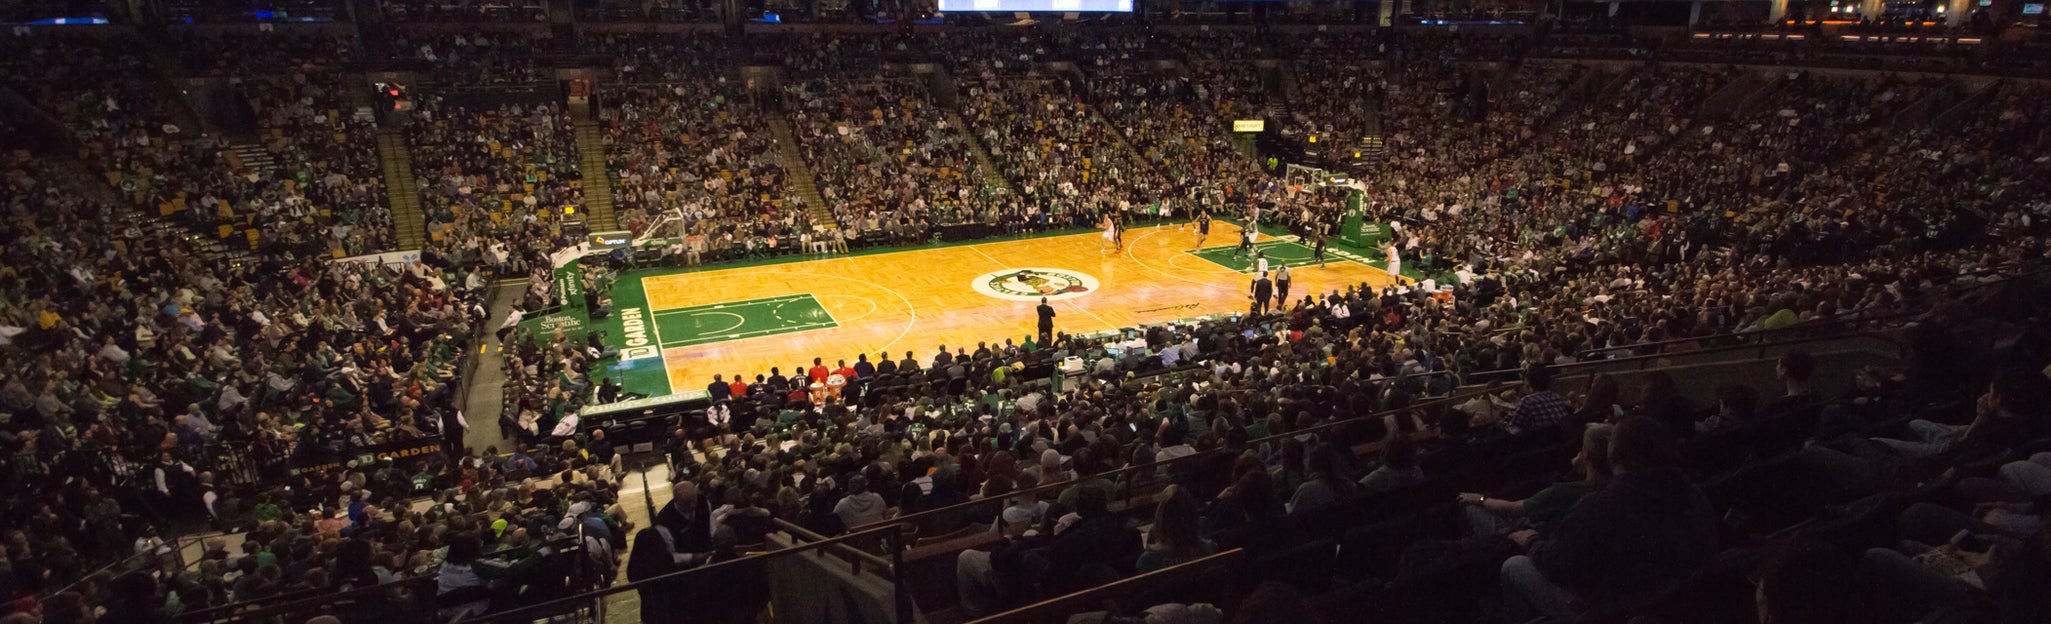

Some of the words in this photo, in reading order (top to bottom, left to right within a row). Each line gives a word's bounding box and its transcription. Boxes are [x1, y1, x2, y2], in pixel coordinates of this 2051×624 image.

[566, 271, 577, 295] xfinity
[540, 317, 580, 329] Scitific
[620, 307, 649, 346] GARDEN
[798, 379, 805, 387] 11
[359, 454, 374, 464] TD
[377, 444, 441, 461] GARDEN
